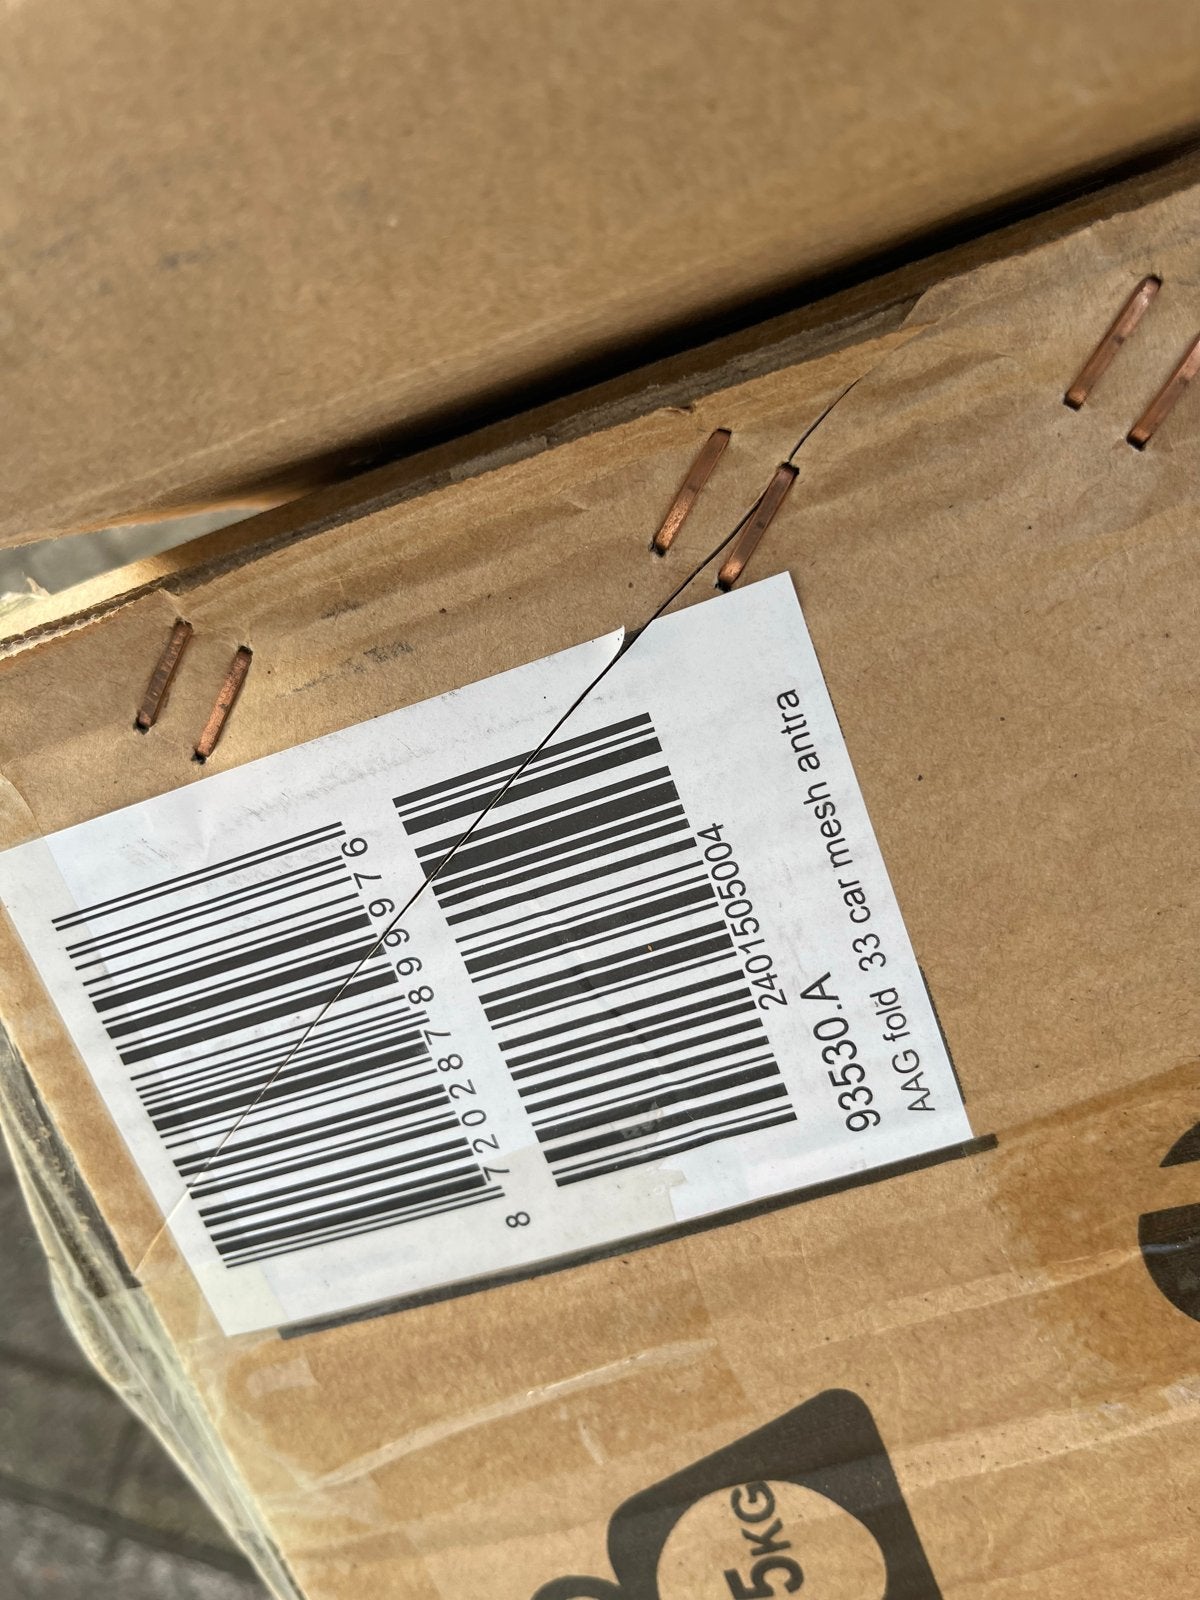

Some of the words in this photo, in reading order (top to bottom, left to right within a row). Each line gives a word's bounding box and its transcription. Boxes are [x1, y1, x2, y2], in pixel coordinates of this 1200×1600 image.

[776, 688, 822, 773] antra
[803, 781, 853, 869] mesh
[695, 822, 788, 1010] 2401505004
[837, 879, 871, 924] car
[852, 933, 887, 972] 33
[869, 987, 911, 1043] fold
[799, 971, 881, 1132] 93530.A
[891, 1048, 936, 1111] AAG
[505, 1210, 531, 1229] 8
